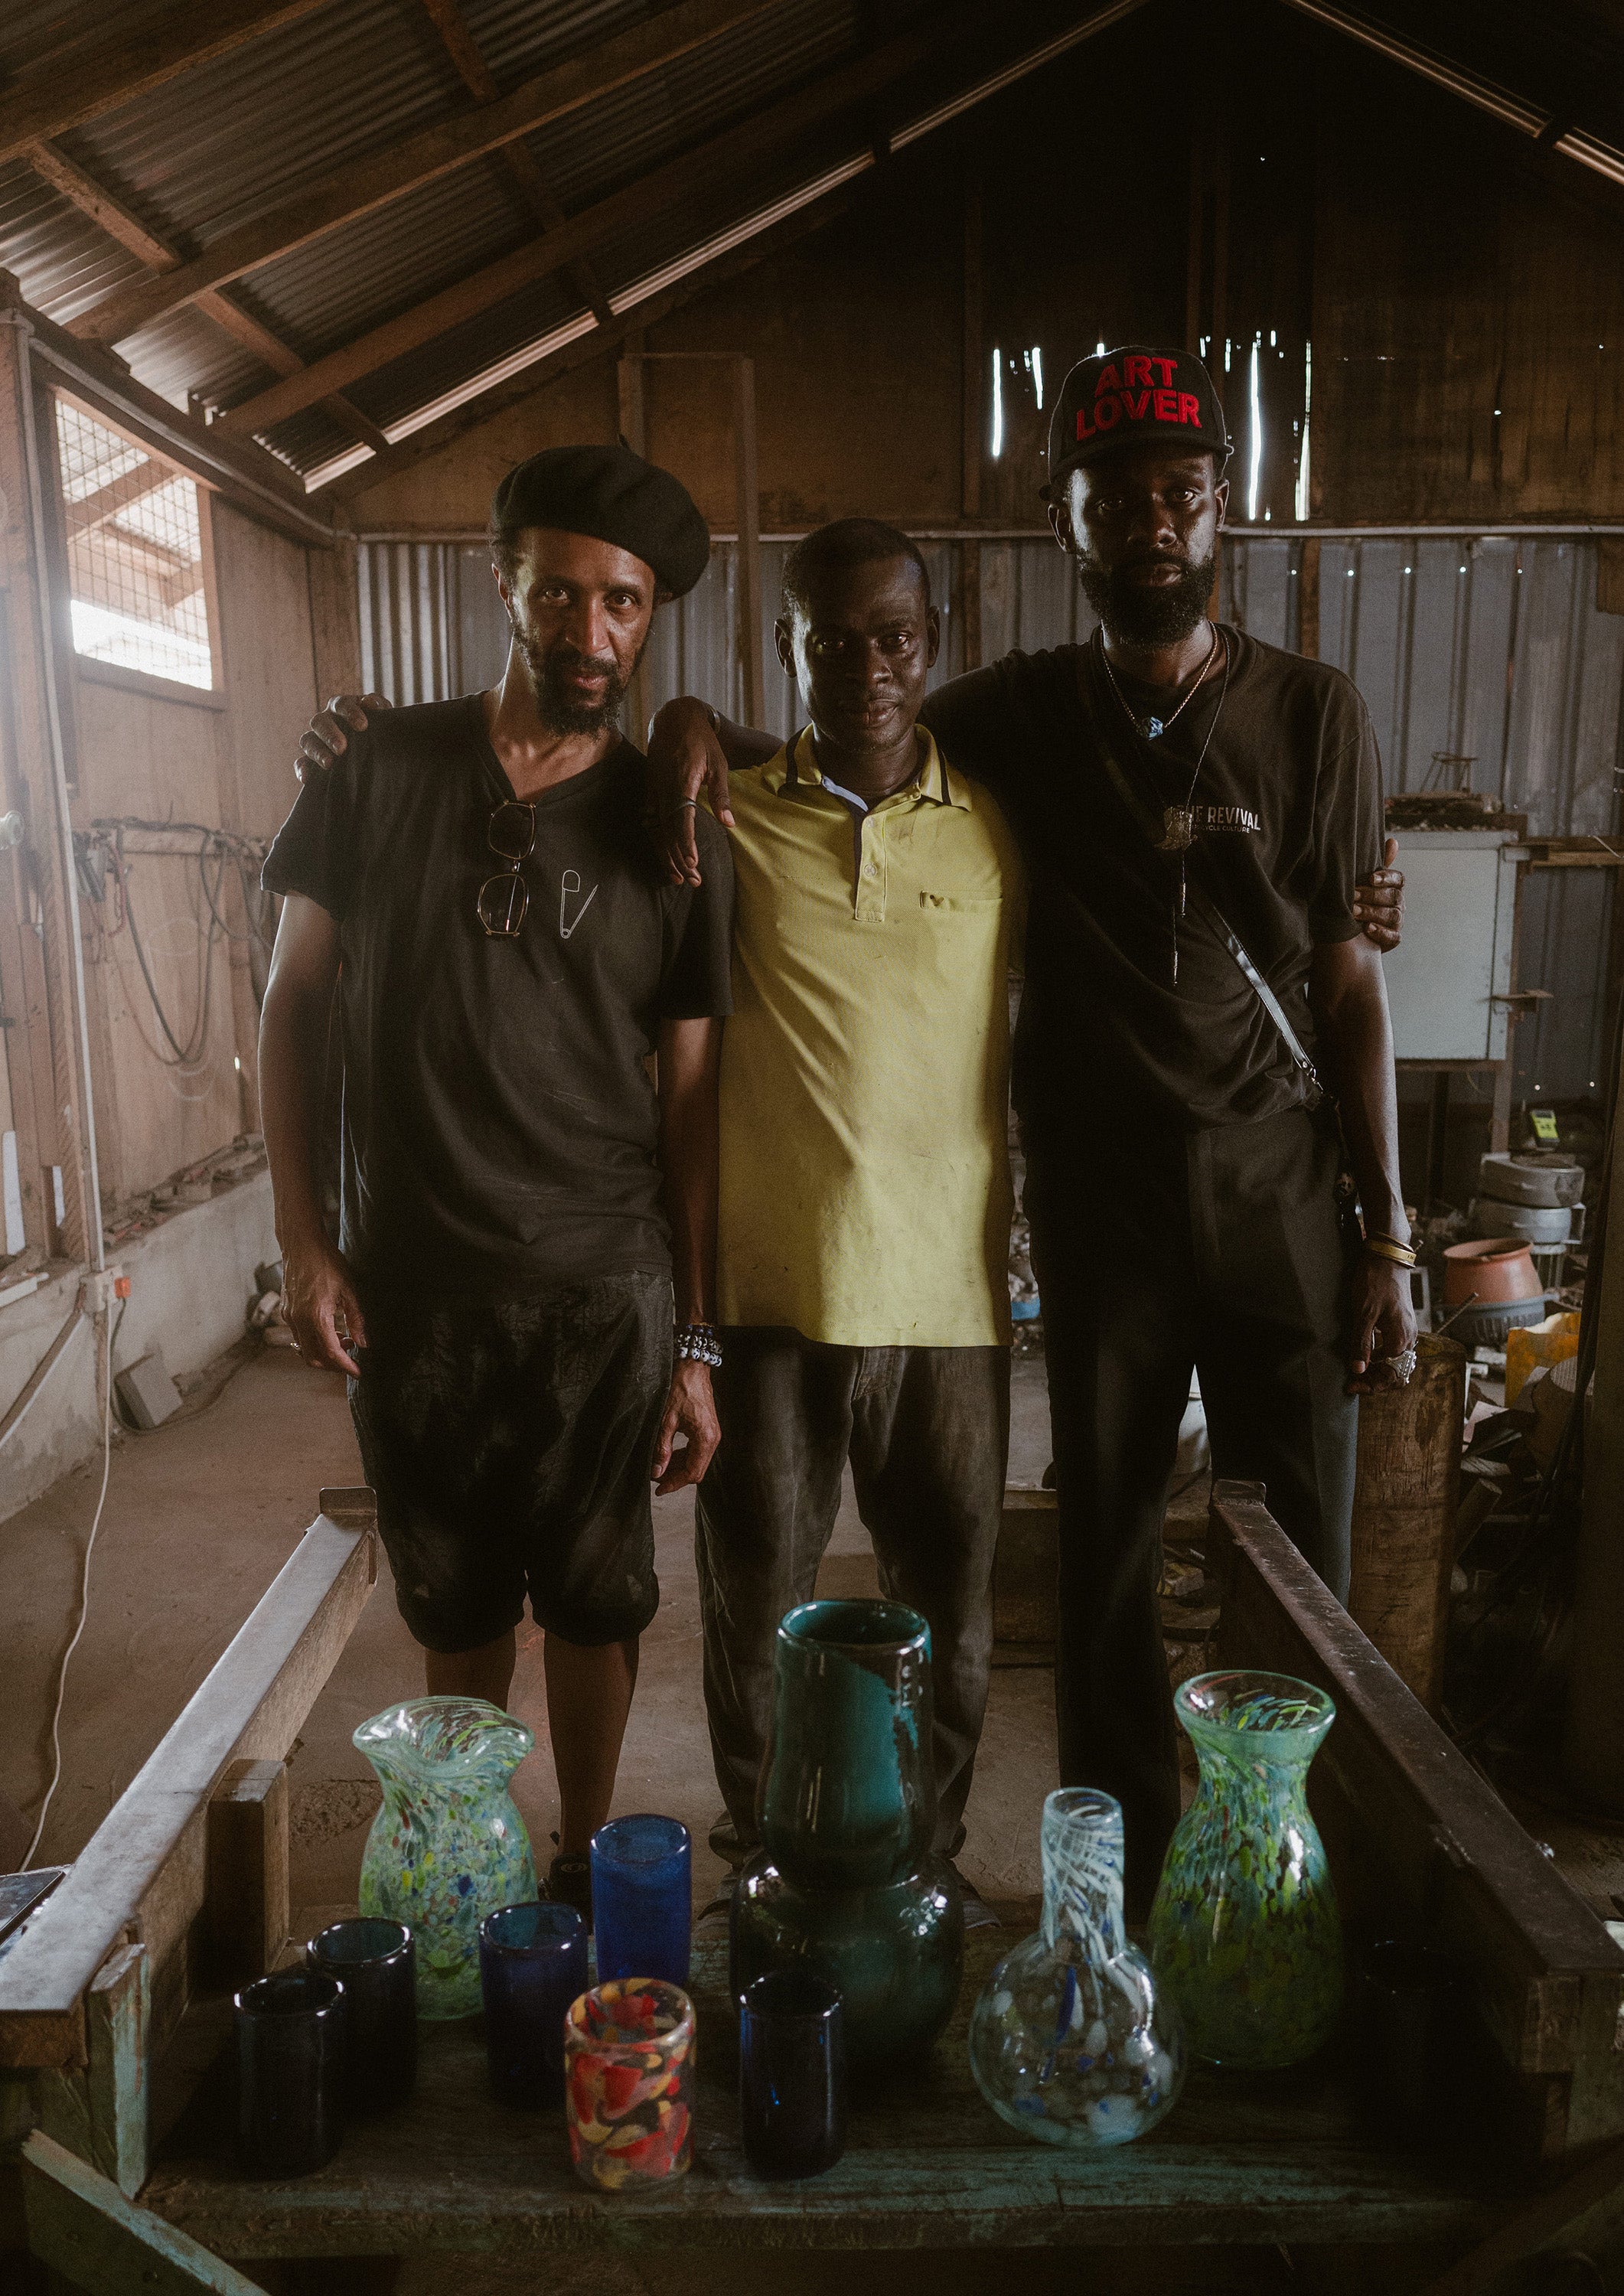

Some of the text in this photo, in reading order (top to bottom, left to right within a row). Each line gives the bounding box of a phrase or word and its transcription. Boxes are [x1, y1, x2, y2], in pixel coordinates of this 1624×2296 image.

[1094, 355, 1178, 397] ART
[1076, 389, 1202, 441] LOVER
[1208, 807, 1261, 830] REVIVAL
